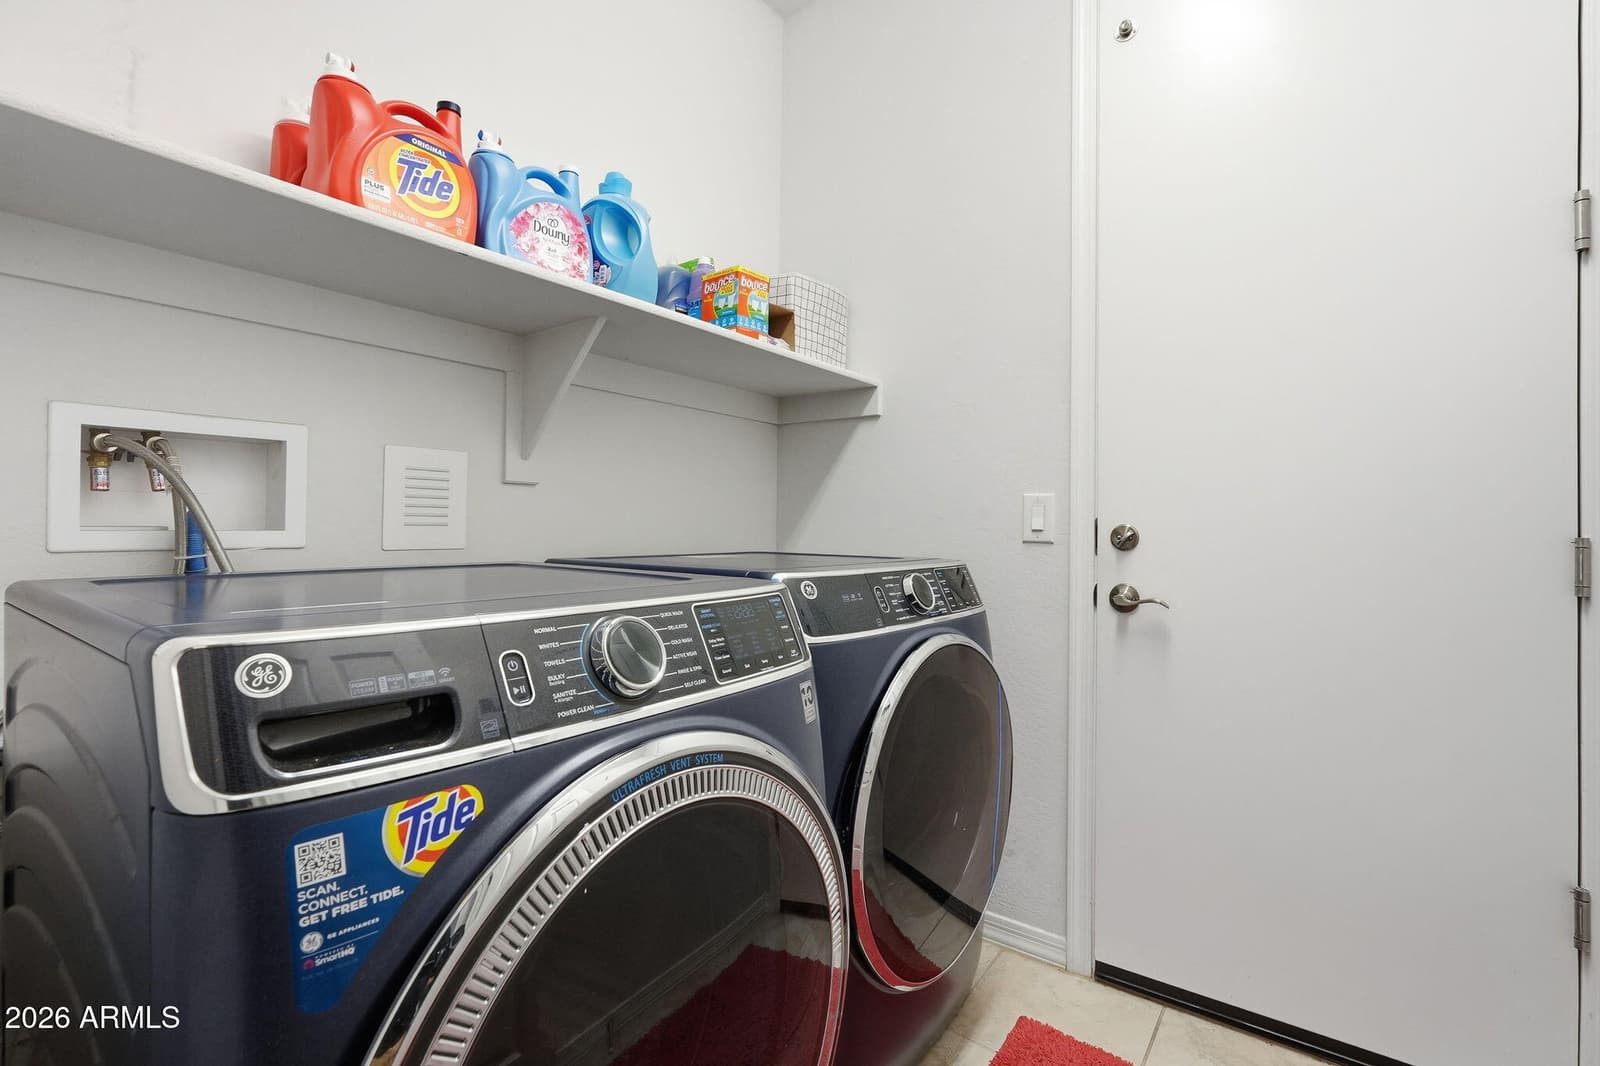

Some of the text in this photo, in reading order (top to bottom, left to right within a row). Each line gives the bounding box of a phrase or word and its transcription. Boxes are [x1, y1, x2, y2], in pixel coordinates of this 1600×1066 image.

[411, 137, 448, 158] ORIGINAL
[364, 178, 386, 192] PLUS
[397, 157, 455, 201] Tide
[533, 220, 570, 247] Downy
[704, 273, 736, 294] bounce
[741, 275, 768, 291] bounce
[534, 626, 558, 634] NORMAL
[539, 642, 560, 650] WHITES
[544, 658, 567, 668] TOWELS
[547, 673, 566, 681] BULKY
[552, 688, 577, 699] SANITIZE
[557, 708, 578, 718] POWER
[577, 704, 595, 714] CLEAN
[611, 753, 724, 802] ULTRAFRESH VENT SYSTEM
[397, 789, 476, 866] Tide
[297, 882, 341, 902] SCAN.
[298, 884, 369, 915] CONNECT.
[299, 885, 405, 927] GET FREE TIDE.
[338, 917, 380, 936] APPLIANCES
[315, 946, 356, 967] SmartHQ
